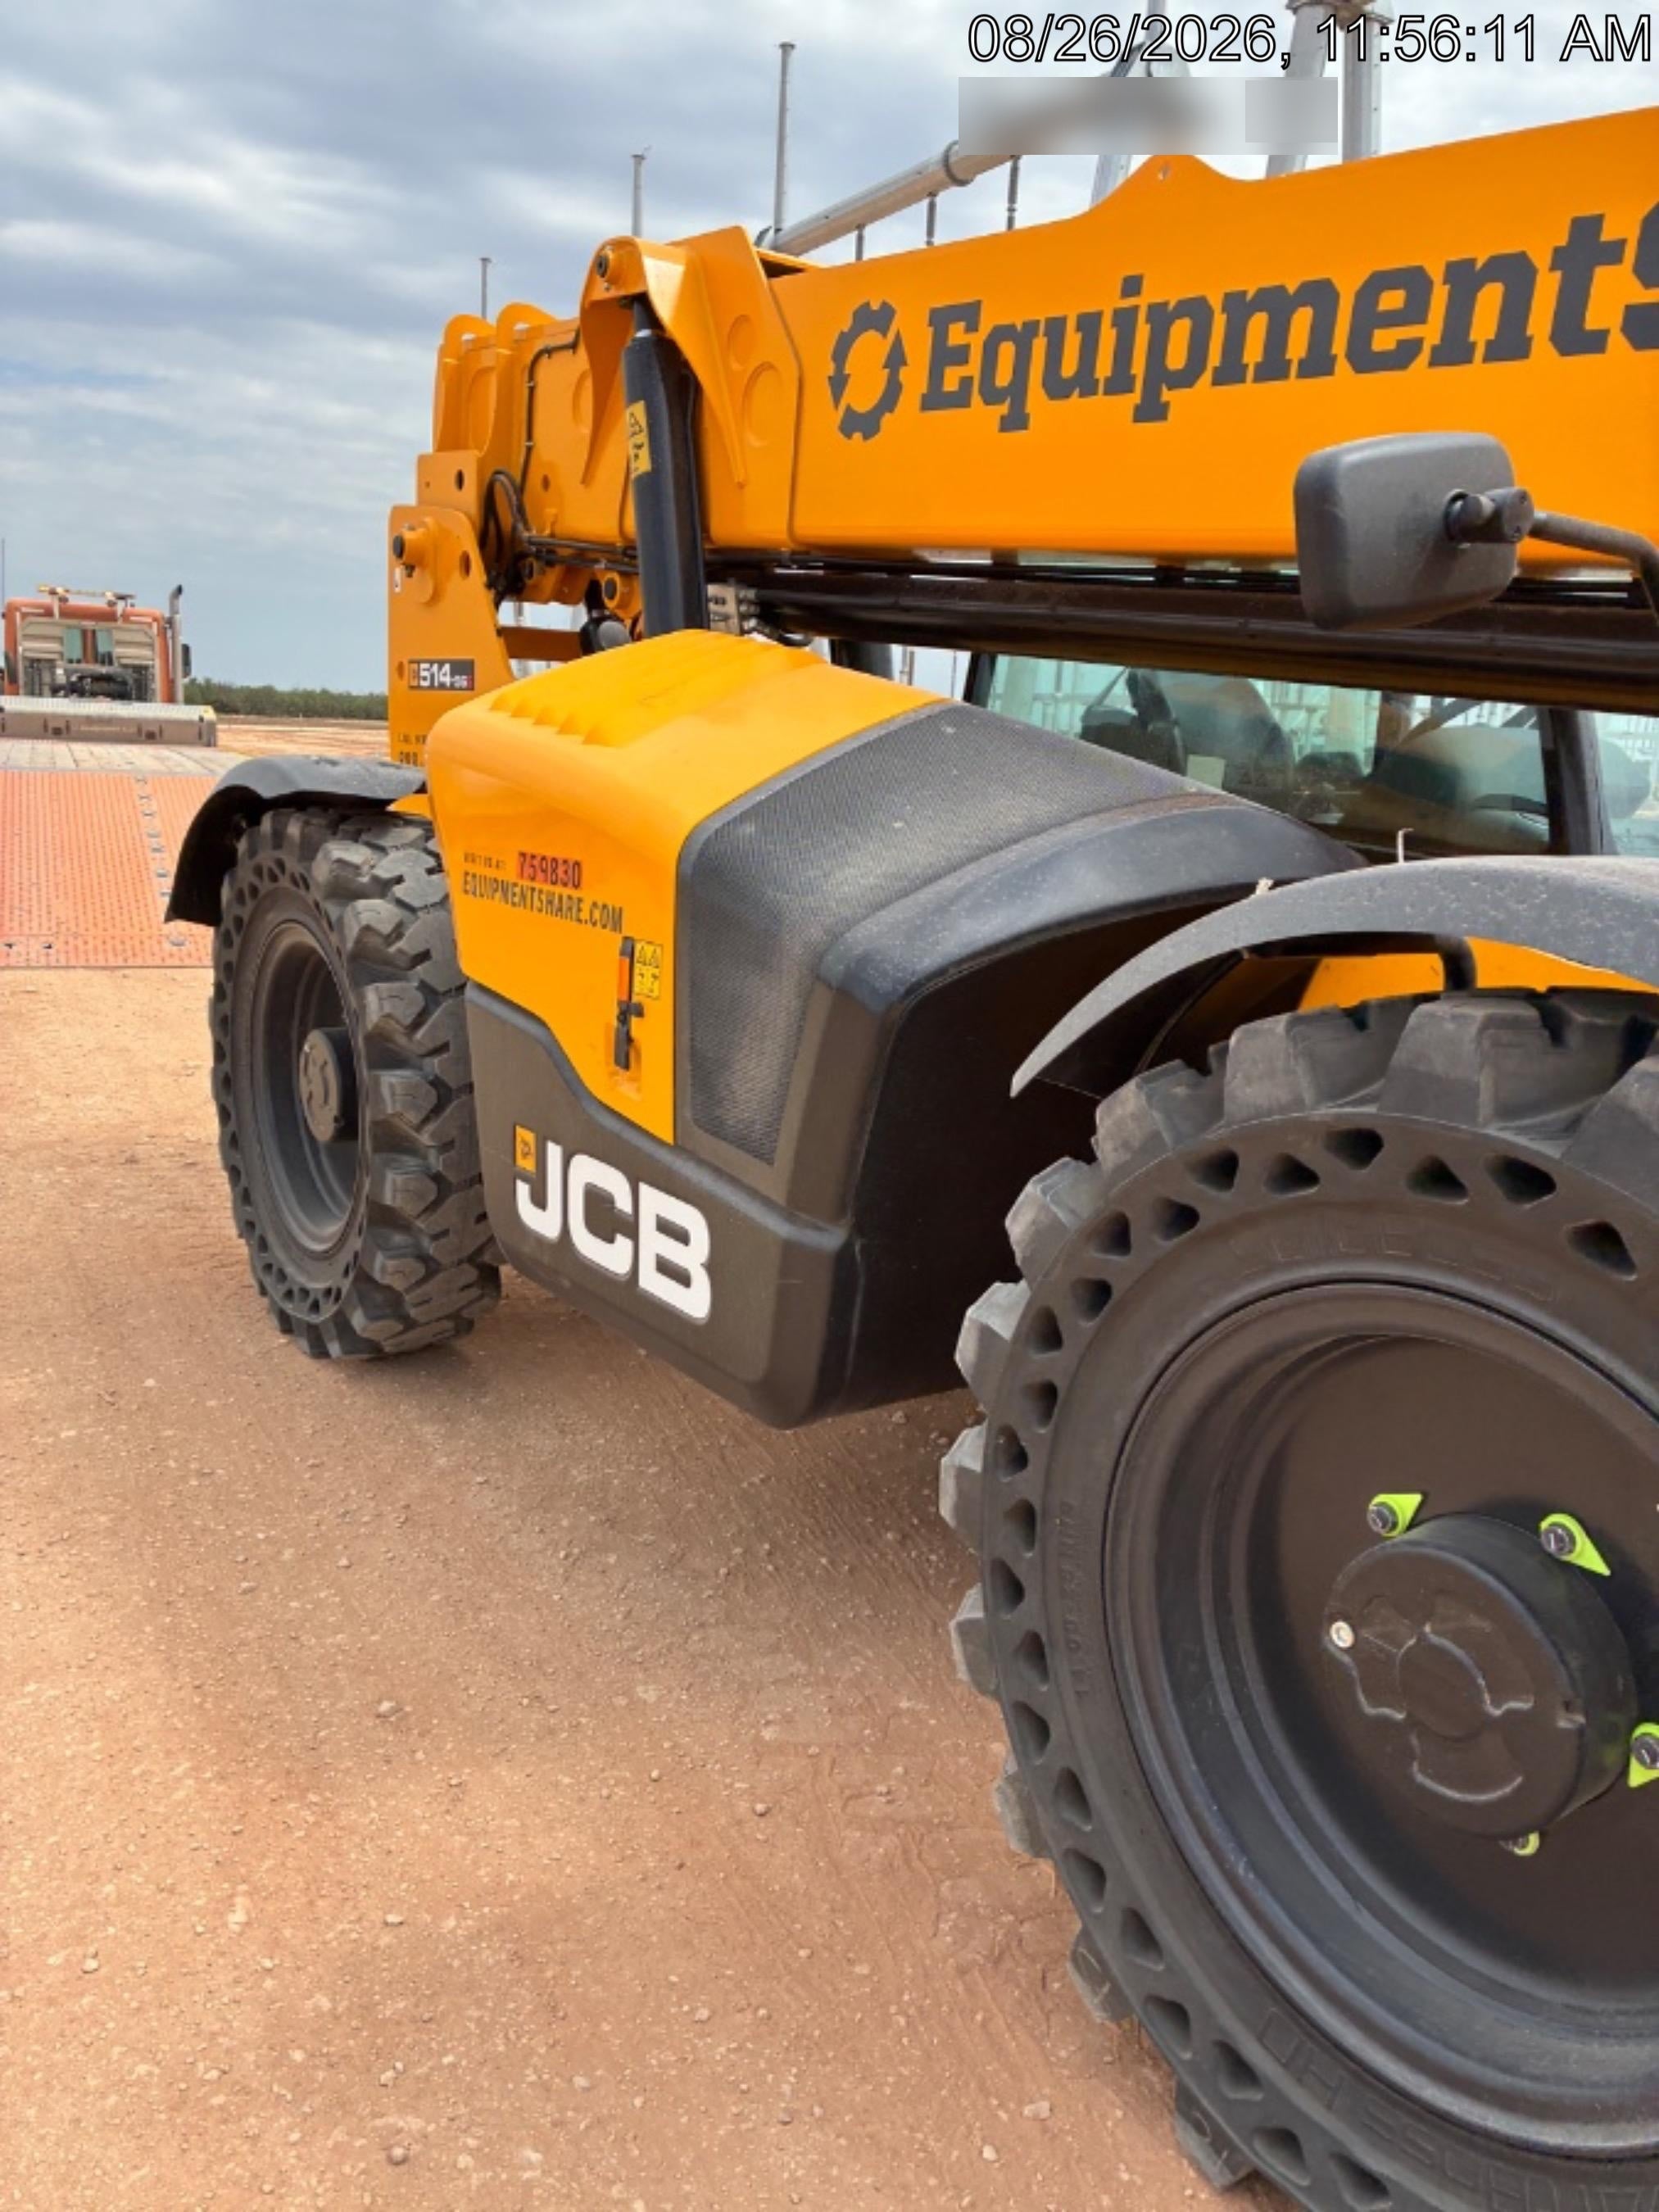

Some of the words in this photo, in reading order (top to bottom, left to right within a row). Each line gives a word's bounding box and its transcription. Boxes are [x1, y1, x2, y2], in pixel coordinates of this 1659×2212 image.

[518, 851, 582, 890] 759830
[462, 871, 623, 935] EQUIPMENTSHARE.COM
[515, 1139, 712, 1321] JCB
